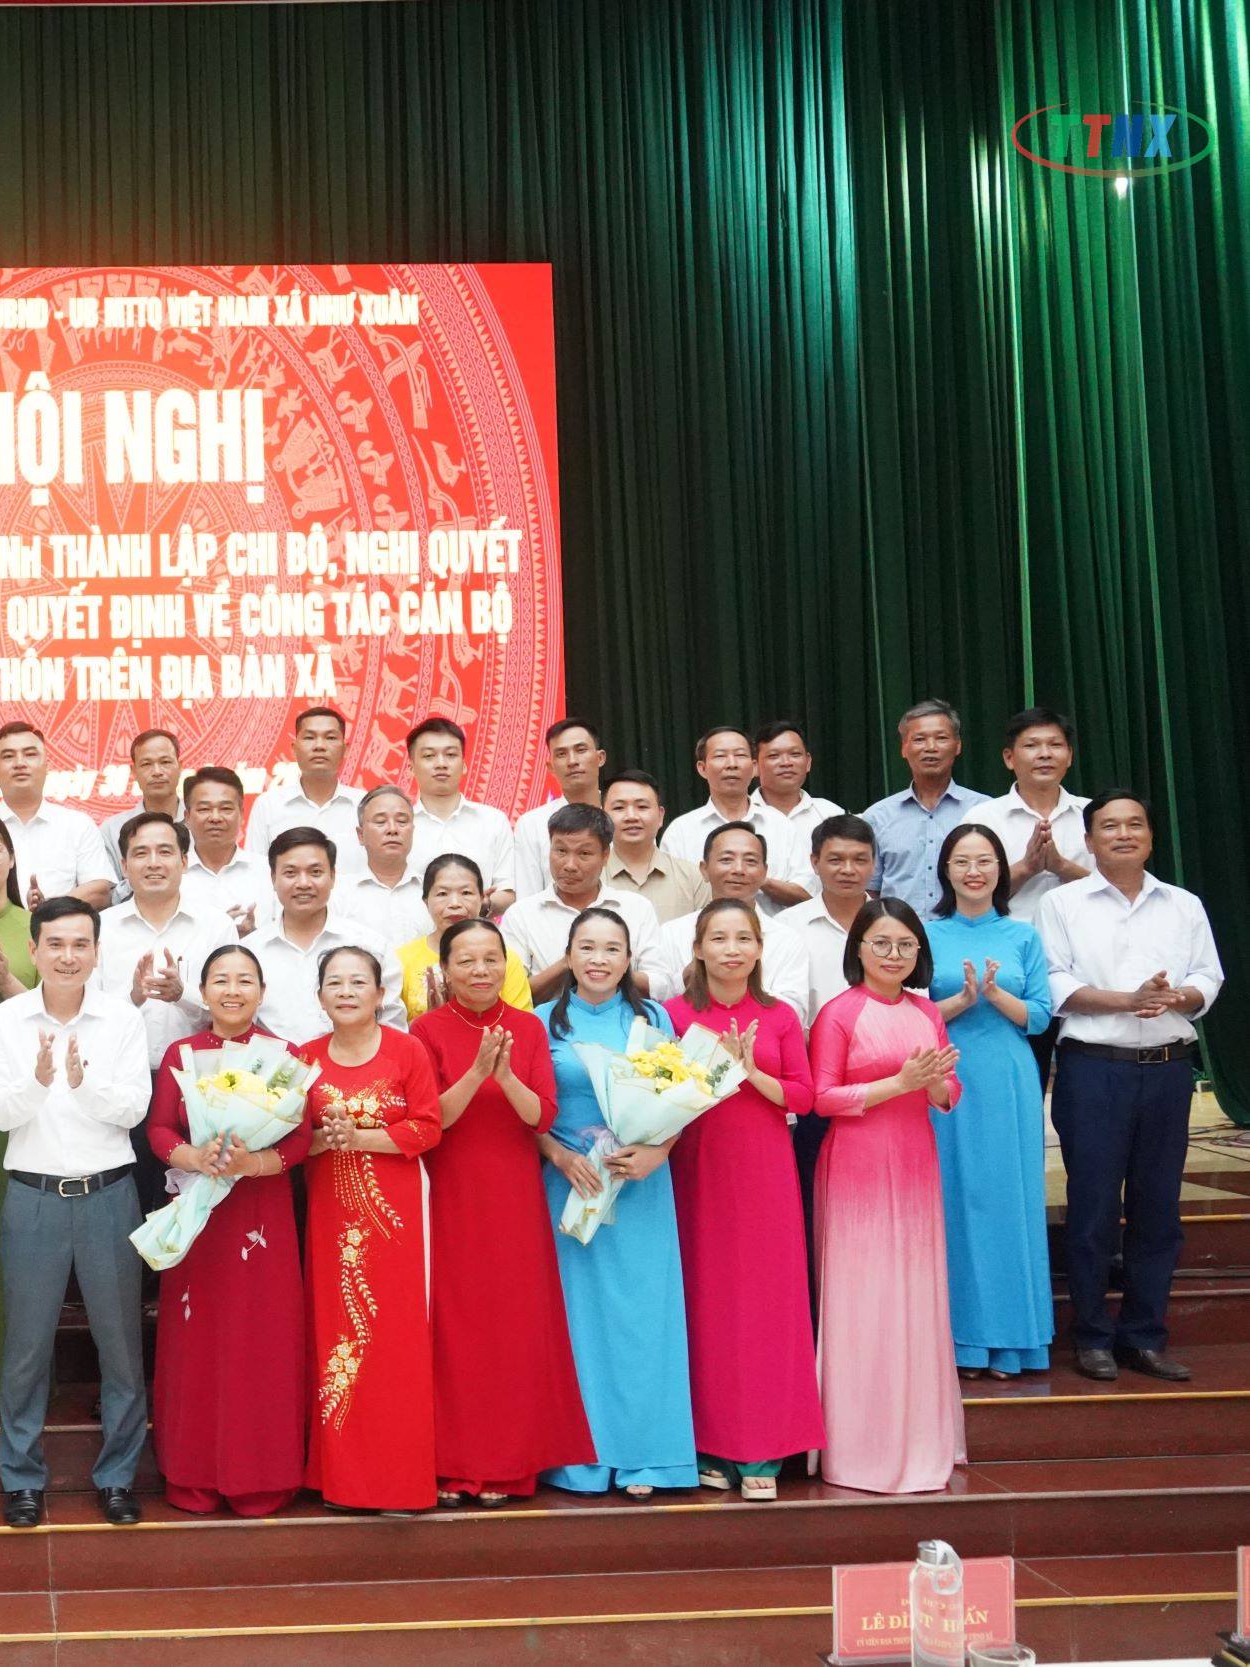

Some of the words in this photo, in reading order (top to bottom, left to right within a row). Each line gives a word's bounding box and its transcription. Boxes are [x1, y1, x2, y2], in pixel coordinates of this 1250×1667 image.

[104, 296, 163, 331] MTTQ
[167, 290, 213, 334] VIỆT
[217, 295, 269, 327] NAM
[274, 289, 305, 326] XÃ
[359, 288, 419, 325] XUÂN
[104, 388, 265, 504] NGHỊ
[48, 525, 151, 578] THÀNH
[160, 523, 218, 587] LẬP
[226, 531, 279, 577] CHI
[286, 522, 338, 585] BỘ,
[344, 530, 420, 583] NGHỊ
[428, 515, 523, 579] QUYẾT
[6, 581, 103, 646] QUYẾT
[110, 594, 186, 648] ĐỊNH
[192, 578, 233, 638] VỀ
[239, 584, 325, 638] CÔNG
[330, 582, 392, 636] TÁC
[399, 581, 464, 636] CÁN
[471, 581, 513, 644] BỘ
[71, 646, 153, 701] TRÊN
[160, 655, 214, 709] ĐỊA
[221, 644, 286, 699] BÀN
[293, 644, 338, 698] XÃ
[861, 1612, 886, 1631] LÊ
